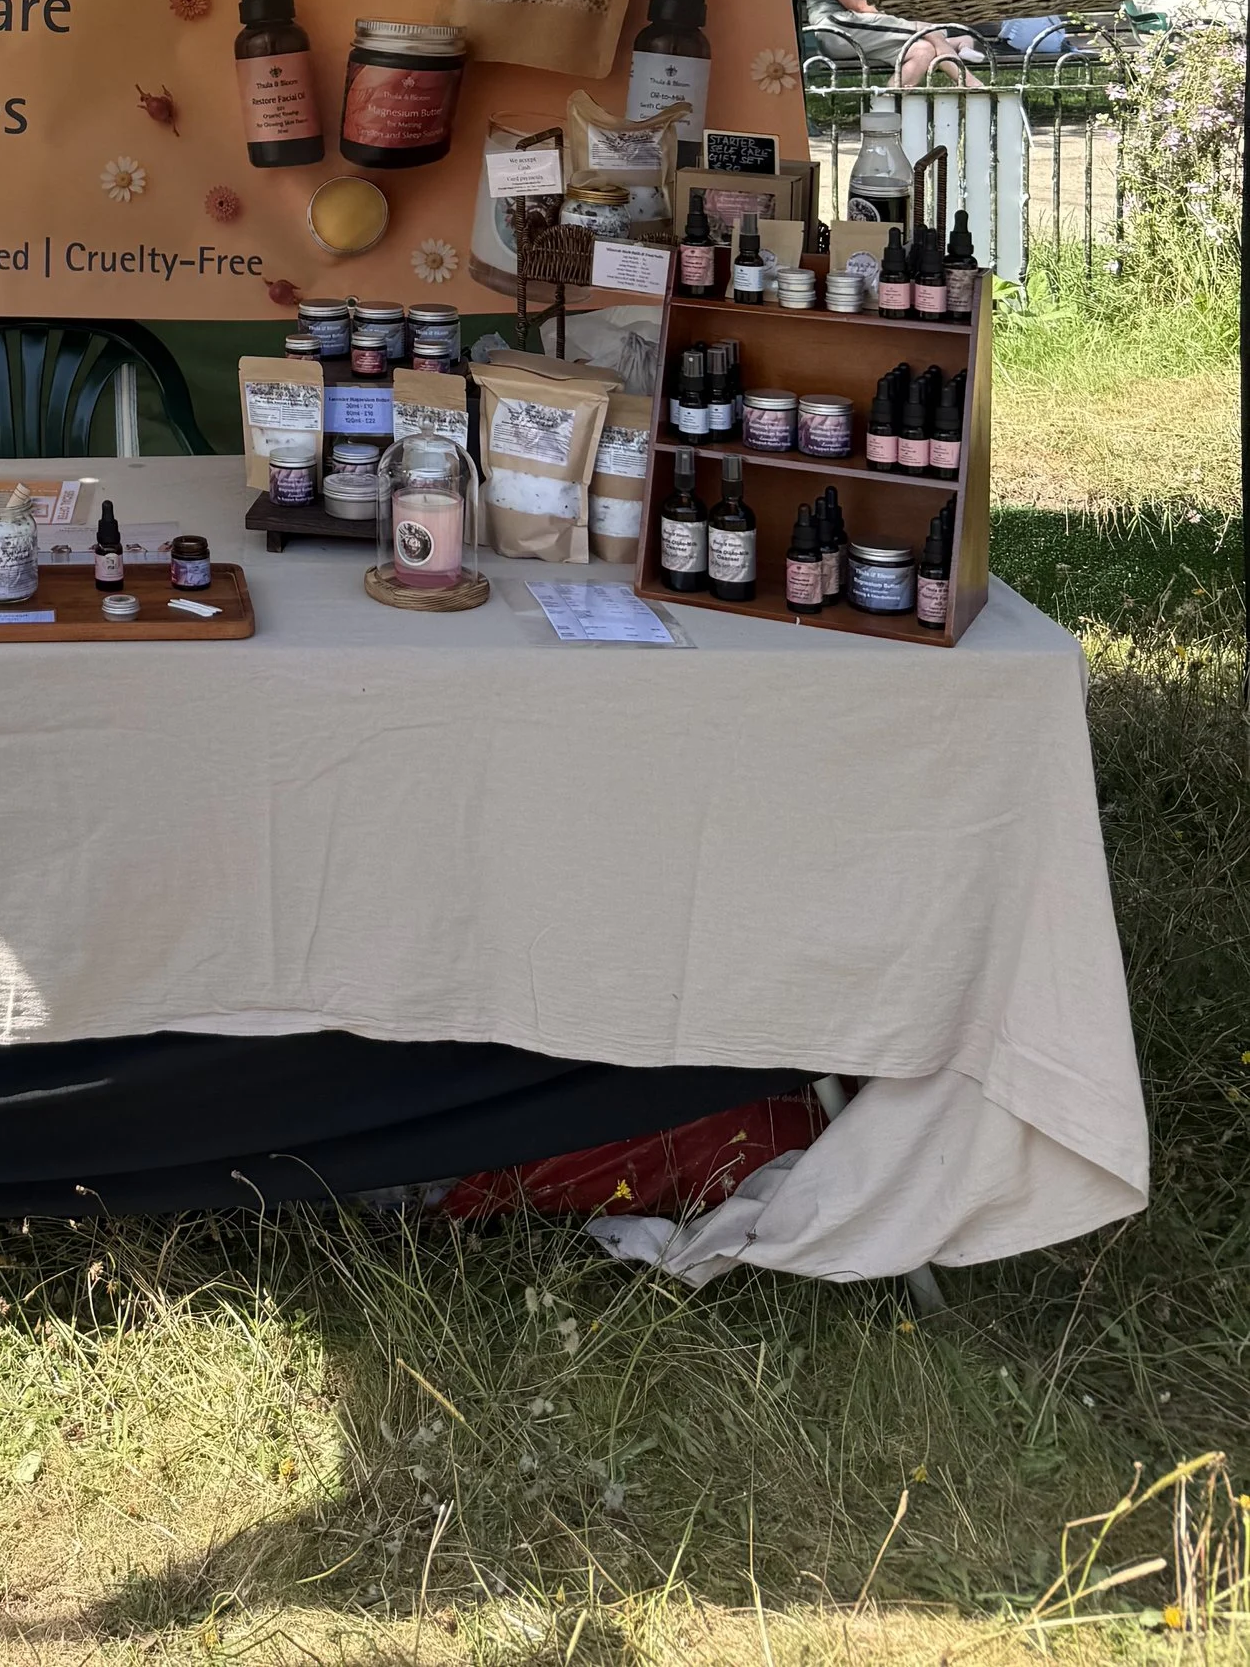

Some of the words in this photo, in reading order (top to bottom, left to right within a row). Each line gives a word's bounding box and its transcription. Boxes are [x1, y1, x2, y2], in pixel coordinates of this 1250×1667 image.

[252, 97, 276, 105] Restore
[277, 93, 297, 103] Facial
[368, 104, 419, 118] Magnesium
[708, 135, 758, 149] STARTER
[710, 145, 738, 154] SELF
[740, 148, 772, 158] CARE
[708, 153, 737, 162] GIFT
[739, 156, 765, 165] SET
[65, 243, 264, 282] Cruelty-Free
